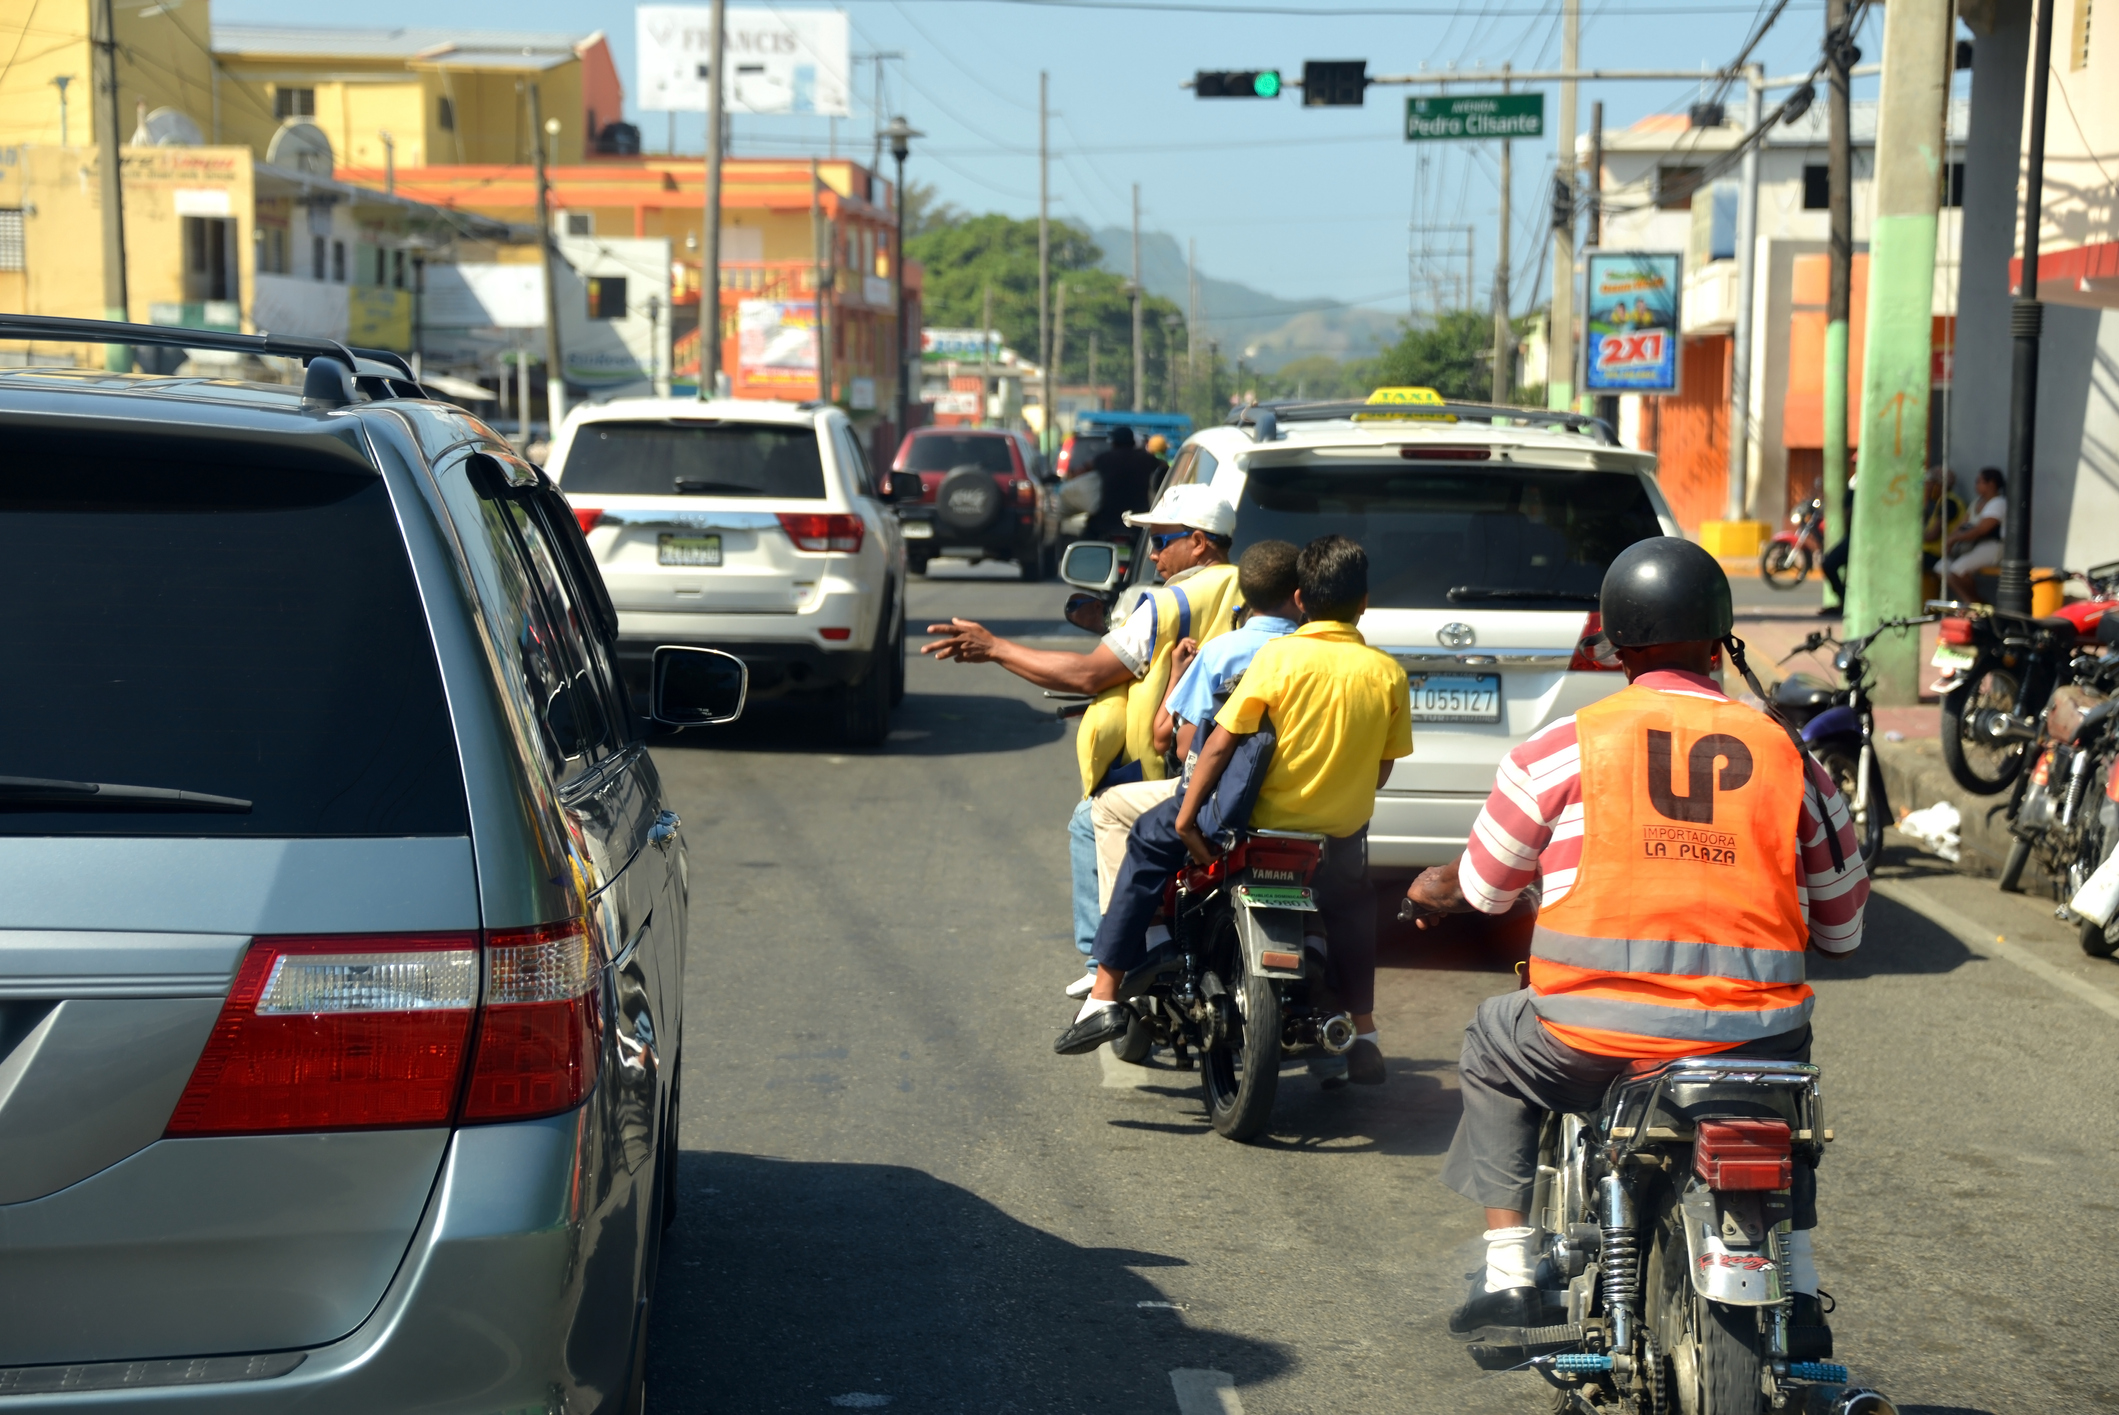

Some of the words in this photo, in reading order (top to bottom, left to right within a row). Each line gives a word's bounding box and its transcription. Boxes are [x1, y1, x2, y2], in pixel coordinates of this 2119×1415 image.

[683, 28, 797, 54] FRANCIS
[1408, 114, 1463, 136] Pedro
[1465, 112, 1540, 134] Clisante
[1602, 332, 1664, 366] 2X1
[1380, 392, 1433, 401] TAXI
[1643, 827, 1736, 847] IMPORTADORA
[1645, 842, 1667, 857] LA
[1679, 844, 1736, 865] PLAZA
[1251, 867, 1295, 881] YAMAHA
